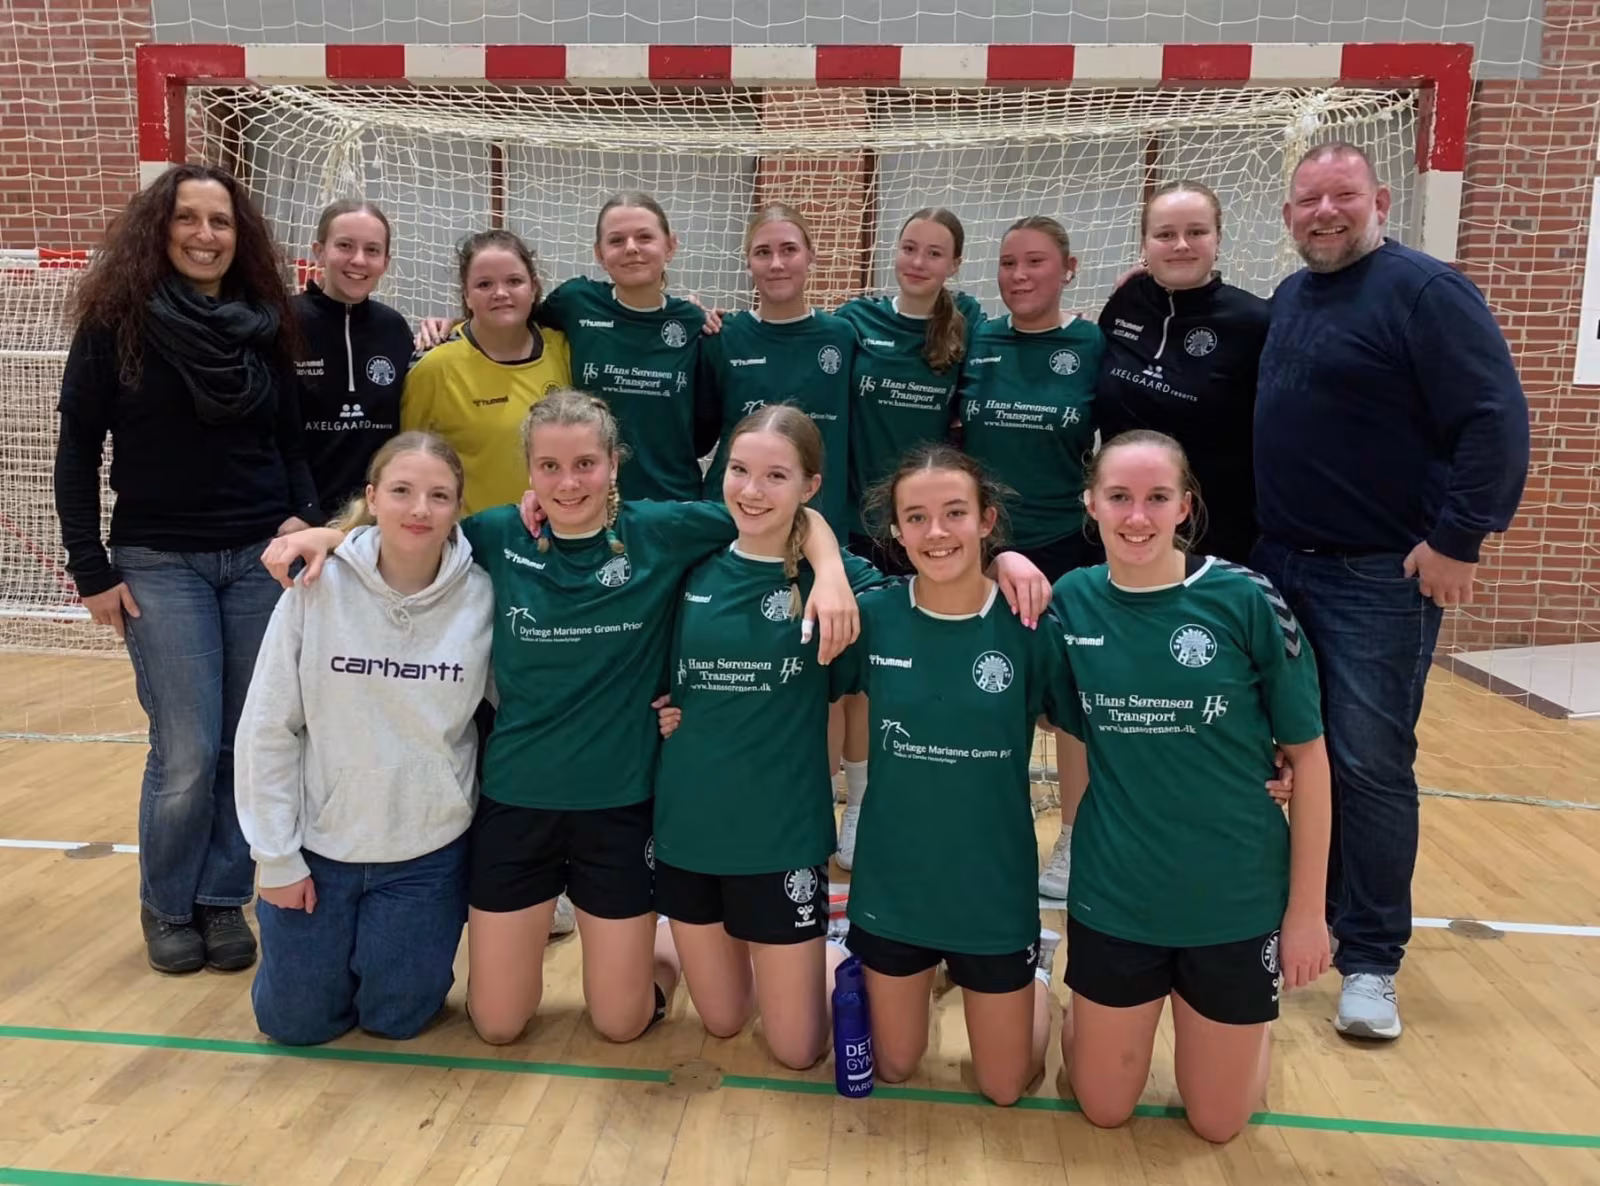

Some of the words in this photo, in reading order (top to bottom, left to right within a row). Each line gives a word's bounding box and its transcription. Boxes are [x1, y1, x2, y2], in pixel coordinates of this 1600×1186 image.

[604, 364, 630, 375] Hans
[631, 367, 673, 379] Sørensen
[614, 375, 661, 388] Transport
[881, 378, 906, 390] Hans
[907, 381, 947, 394] Sørensen
[1110, 368, 1170, 393] AXELGAARD
[890, 389, 934, 403] Transport
[985, 400, 1011, 410] Hans
[1013, 401, 1058, 413] Sørensen
[995, 410, 1043, 422] Transport
[512, 553, 546, 570] hummel
[520, 626, 551, 637] Dyrlæge
[553, 627, 592, 636] Marianne
[594, 624, 621, 634] Grønn
[623, 622, 644, 632] Prior
[331, 656, 463, 682] carhartt
[688, 658, 715, 670] Hans
[717, 658, 772, 670] Sørensen
[876, 655, 912, 669] hummel
[699, 671, 756, 684] Transport
[1095, 693, 1126, 707] Hans
[1128, 694, 1194, 709] Sørensen
[1108, 709, 1177, 726] Transport
[893, 739, 926, 754] Dyrlæge
[928, 745, 969, 757] Marianne
[971, 749, 998, 758] Grønn
[845, 1037, 871, 1057] DET
